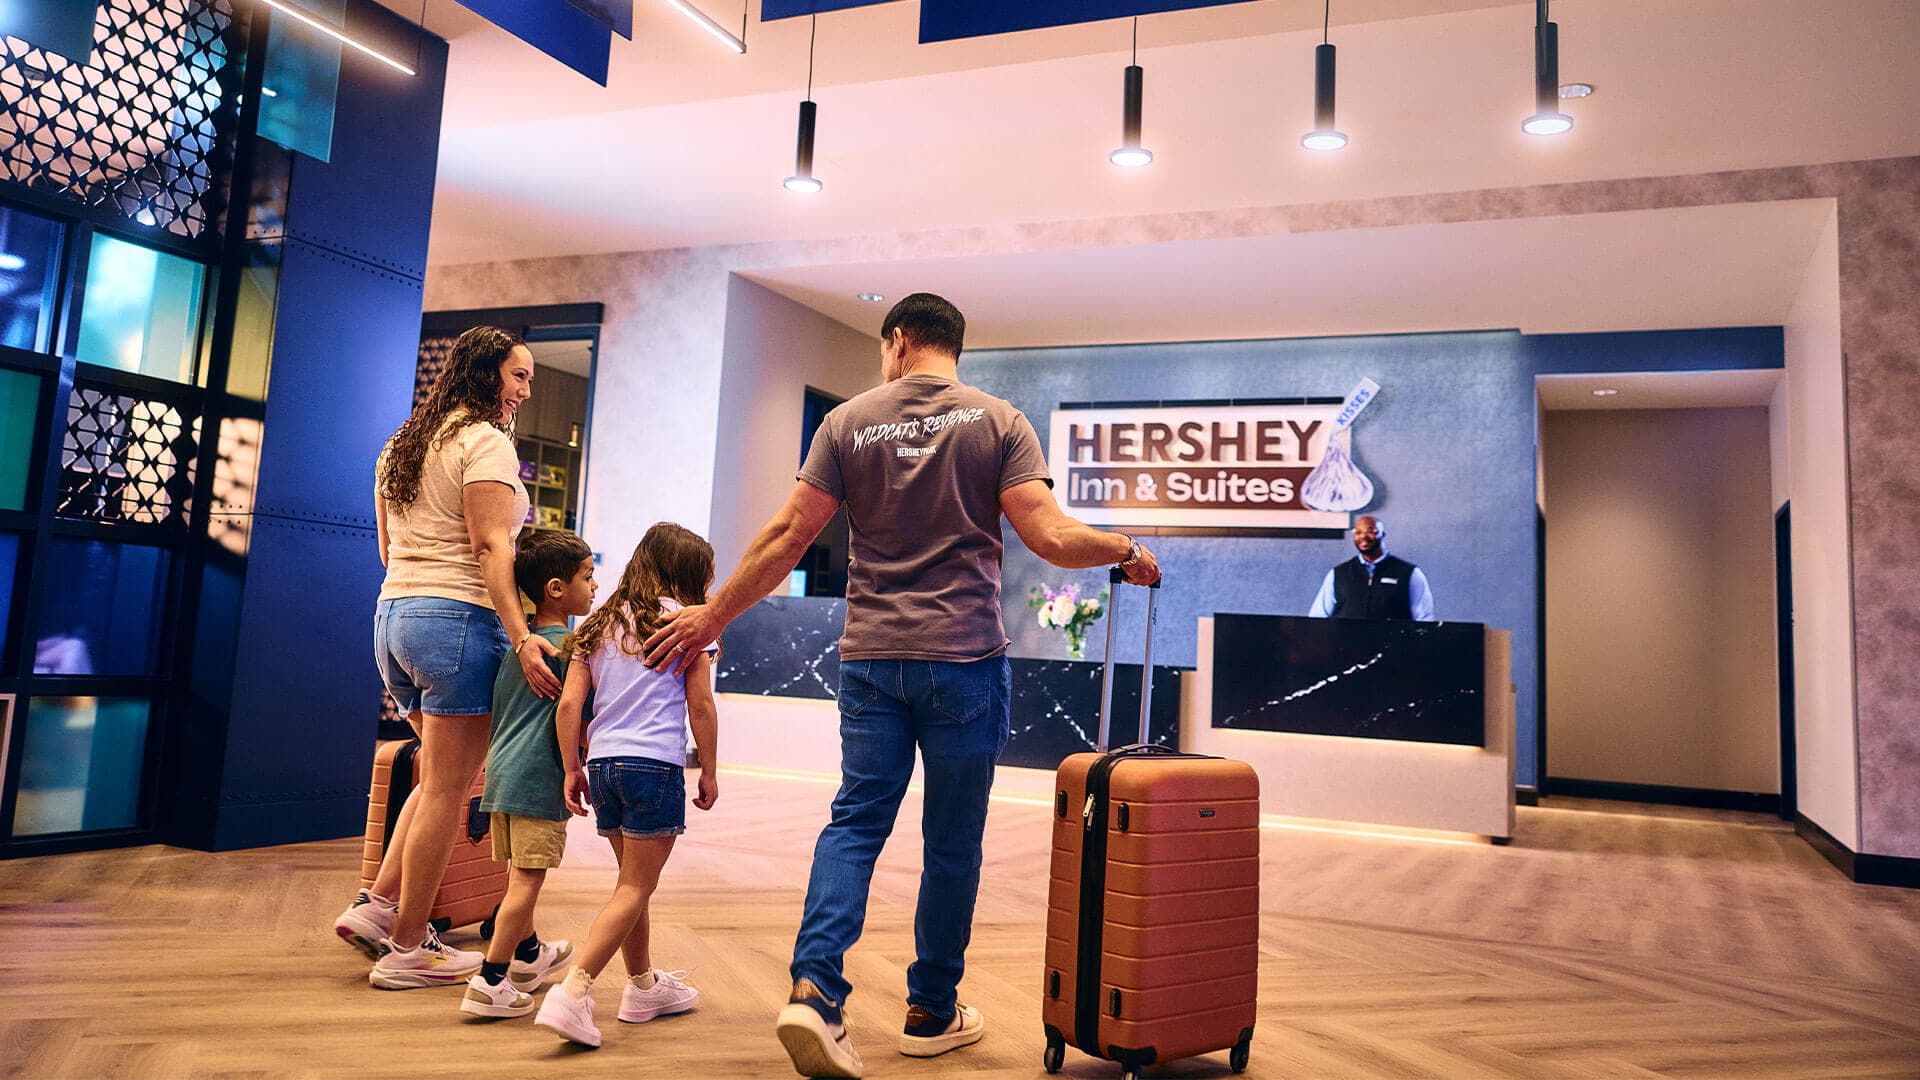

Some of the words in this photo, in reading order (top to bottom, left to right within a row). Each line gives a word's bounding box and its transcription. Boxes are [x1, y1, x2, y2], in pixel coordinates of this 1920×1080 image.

[1336, 389, 1370, 425] KISSES
[852, 417, 920, 454] WILDCAT'S
[921, 407, 985, 438] REVENGE
[1068, 420, 1322, 462] HERSHEY
[1071, 472, 1127, 501] Inn
[1135, 473, 1159, 501] &
[1166, 470, 1295, 503] Suites
